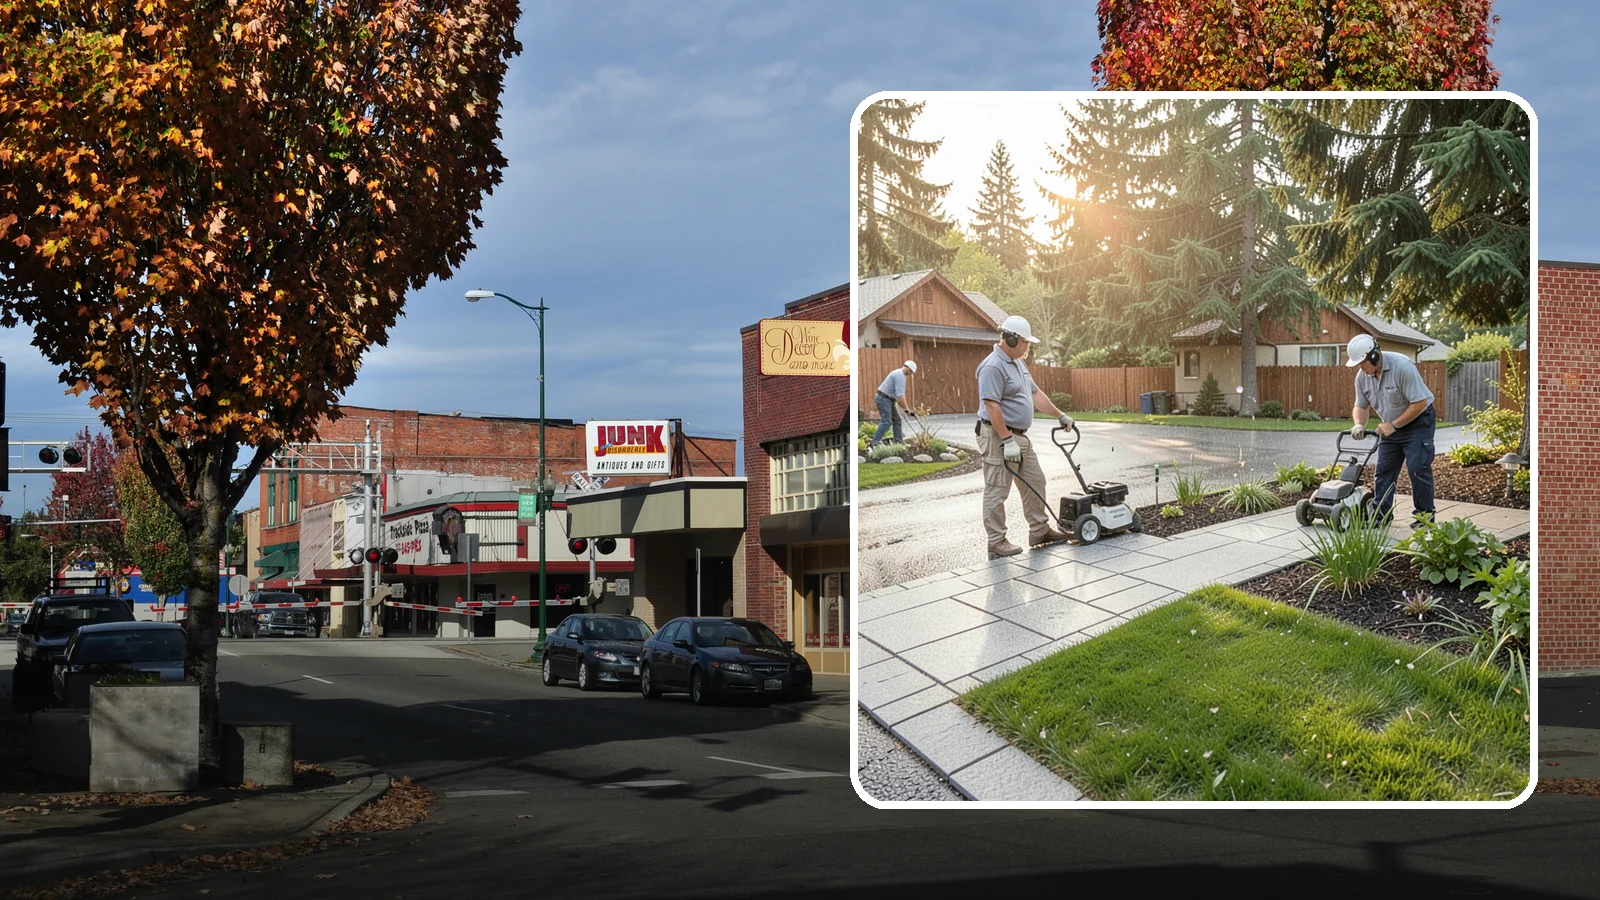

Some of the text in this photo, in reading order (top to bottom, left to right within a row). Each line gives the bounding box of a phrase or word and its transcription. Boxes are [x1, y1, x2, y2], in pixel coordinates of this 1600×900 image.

[596, 425, 665, 457] JUNK
[607, 446, 645, 454] DISORDERLY
[597, 461, 666, 470] ANTIQUES AND GIFTS
[414, 520, 429, 535] Pizza
